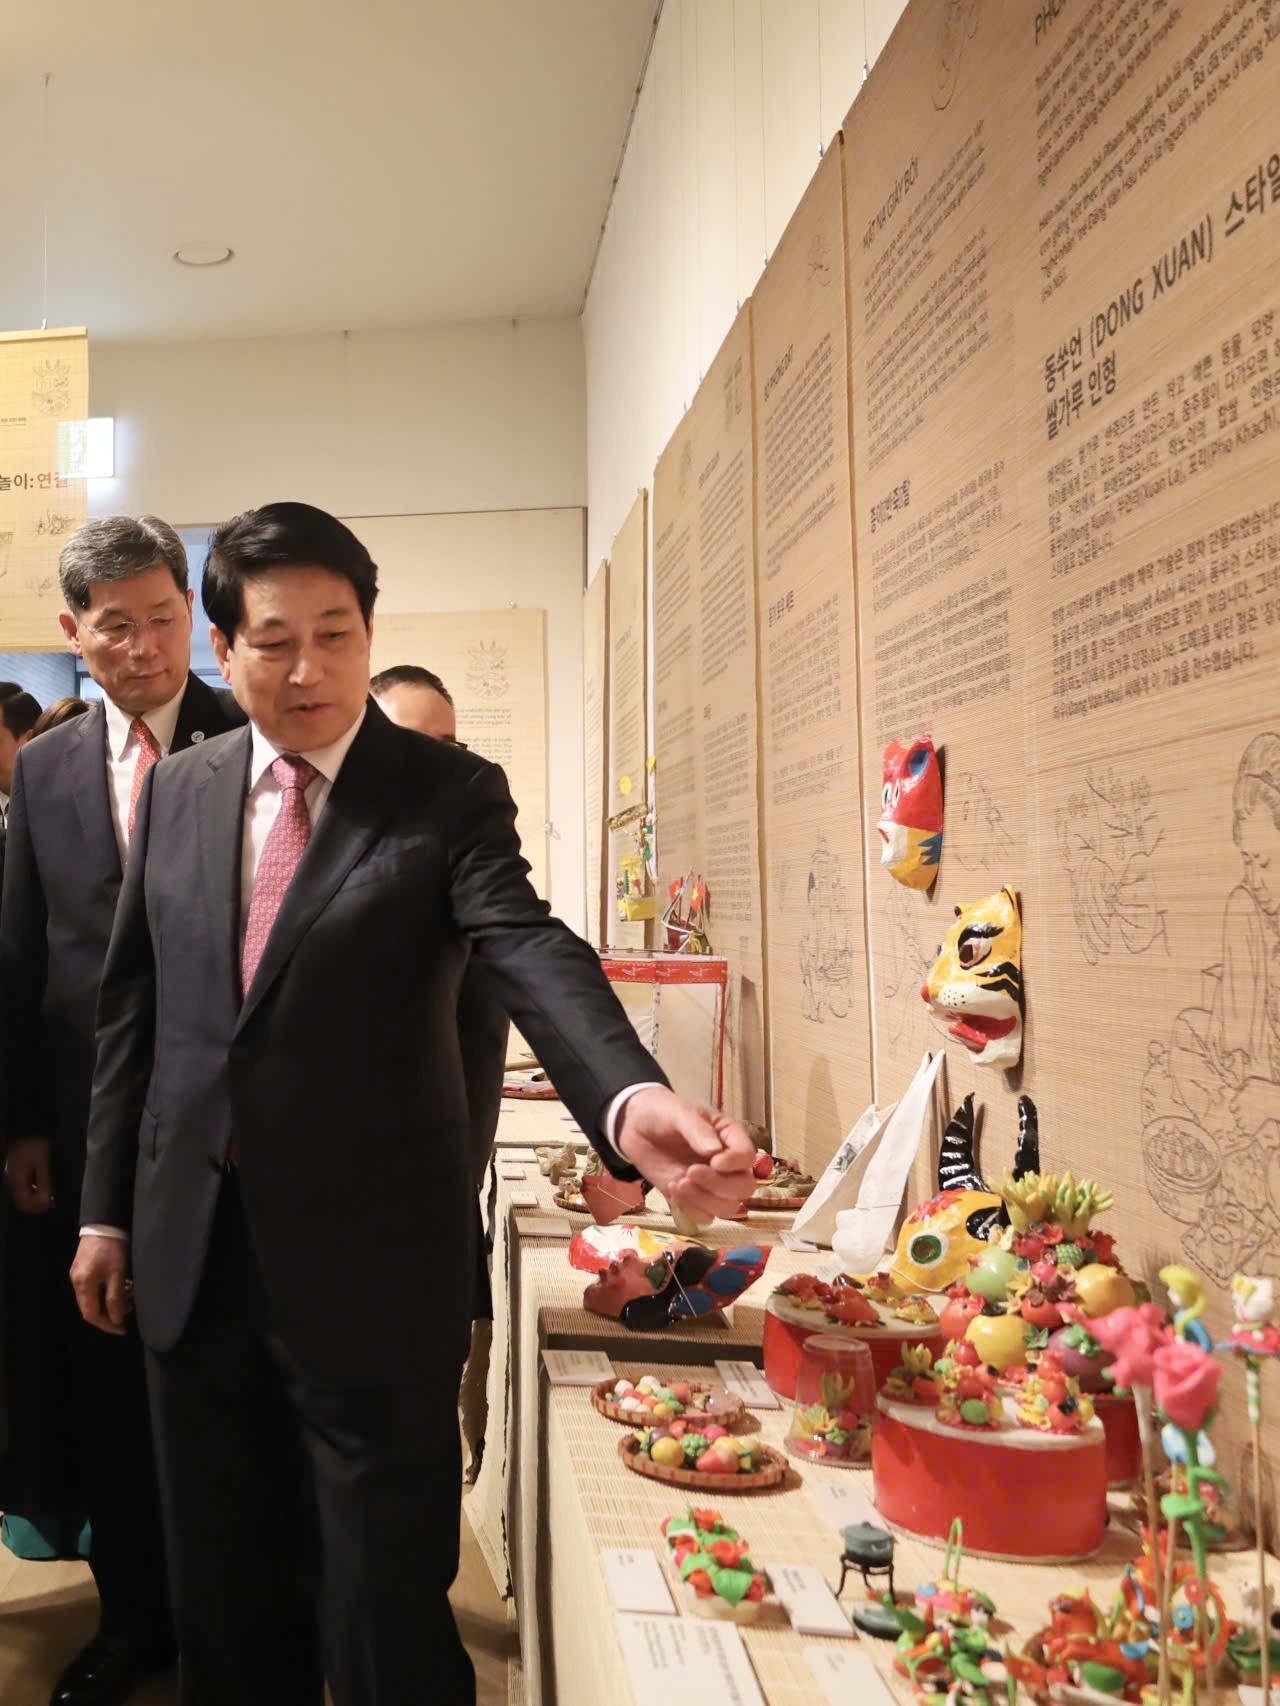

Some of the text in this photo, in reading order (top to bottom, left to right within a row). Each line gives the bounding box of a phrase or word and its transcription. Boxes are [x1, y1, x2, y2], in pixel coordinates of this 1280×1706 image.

[1045, 153, 1280, 393] 동쑤언 (DONG XUAN) 스타일
[1142, 392, 1158, 420] 만든
[1222, 333, 1240, 365] 동물
[1251, 310, 1273, 342] 모양
[1225, 346, 1267, 390] 다가오면
[1046, 350, 1117, 441] 쌀가루 인형
[1218, 397, 1238, 429] 찹쌀
[1157, 548, 1183, 574] 기술은
[1206, 579, 1251, 614] 있습니다.
